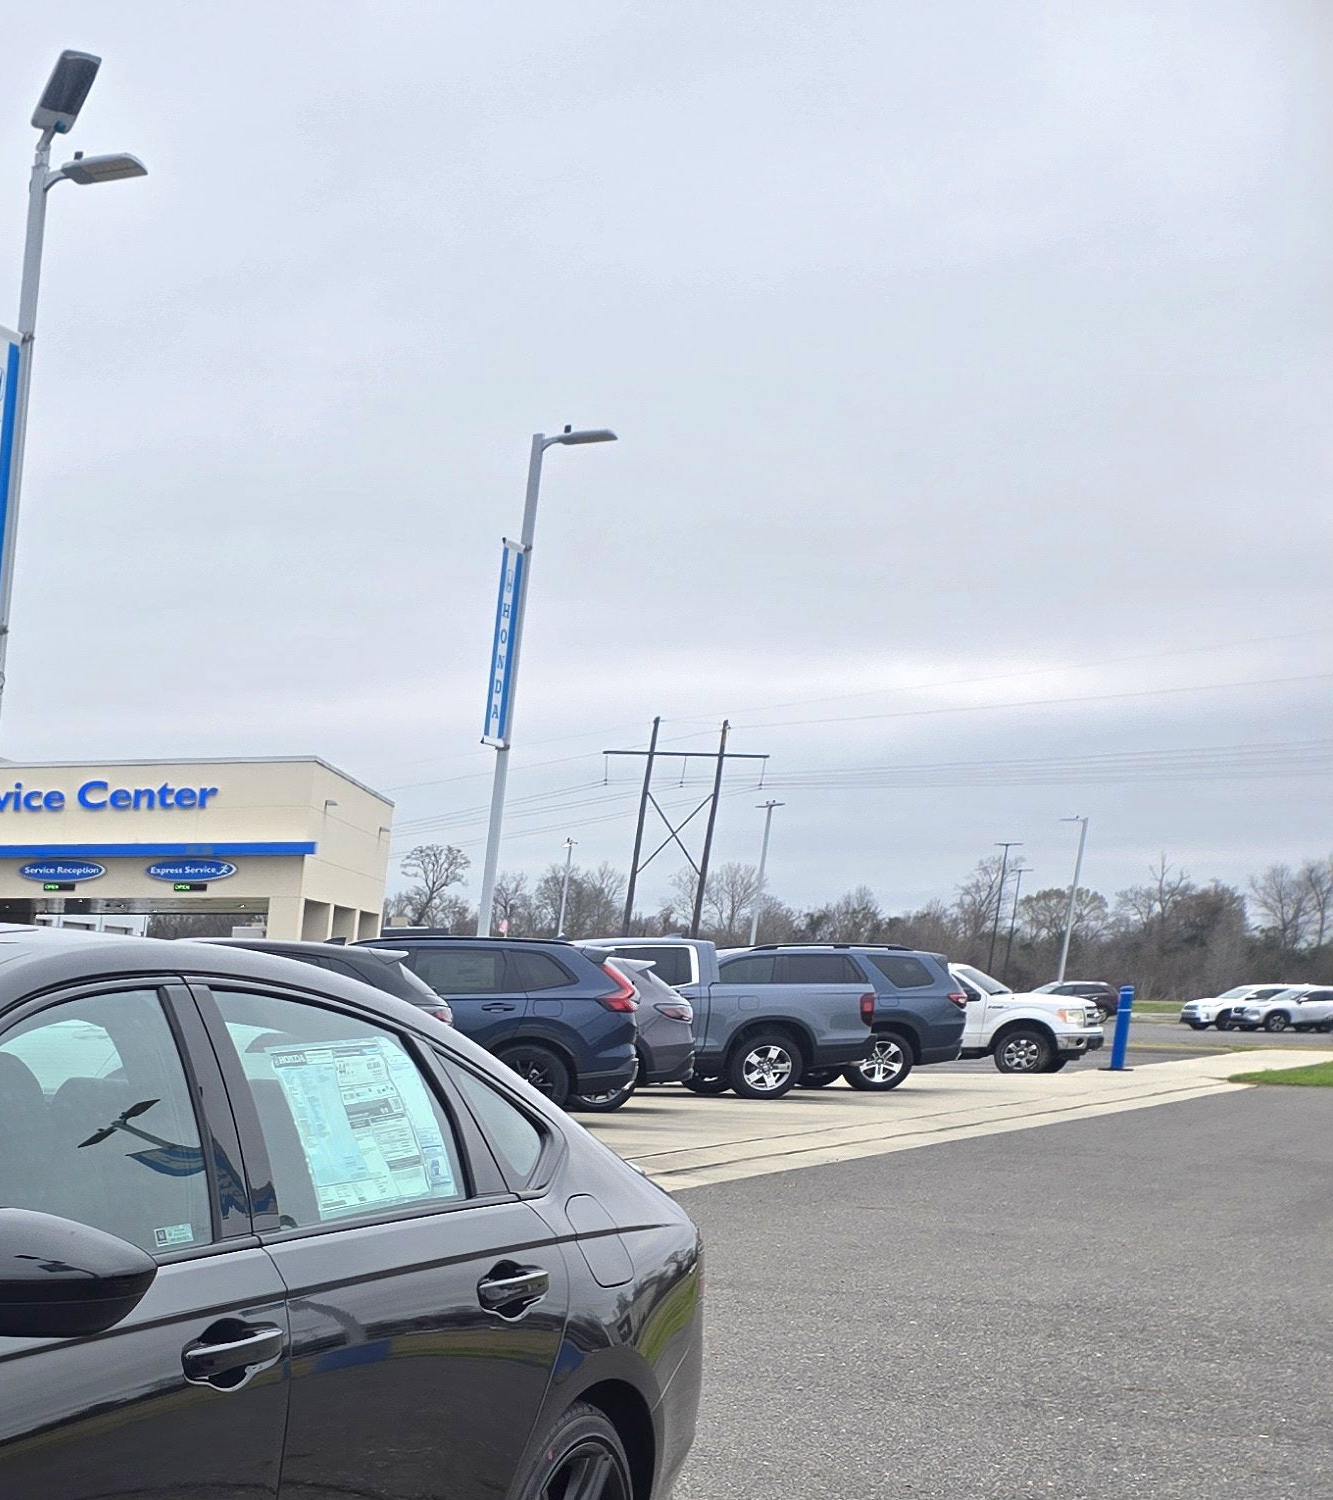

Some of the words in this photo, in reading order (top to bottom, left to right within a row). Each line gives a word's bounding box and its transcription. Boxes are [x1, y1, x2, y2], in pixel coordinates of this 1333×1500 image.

[491, 602, 511, 719] HONDA
[76, 779, 219, 810] Center
[24, 866, 55, 874] Service
[57, 866, 99, 876] Reception
[150, 865, 183, 876] Express
[184, 865, 217, 875] Service
